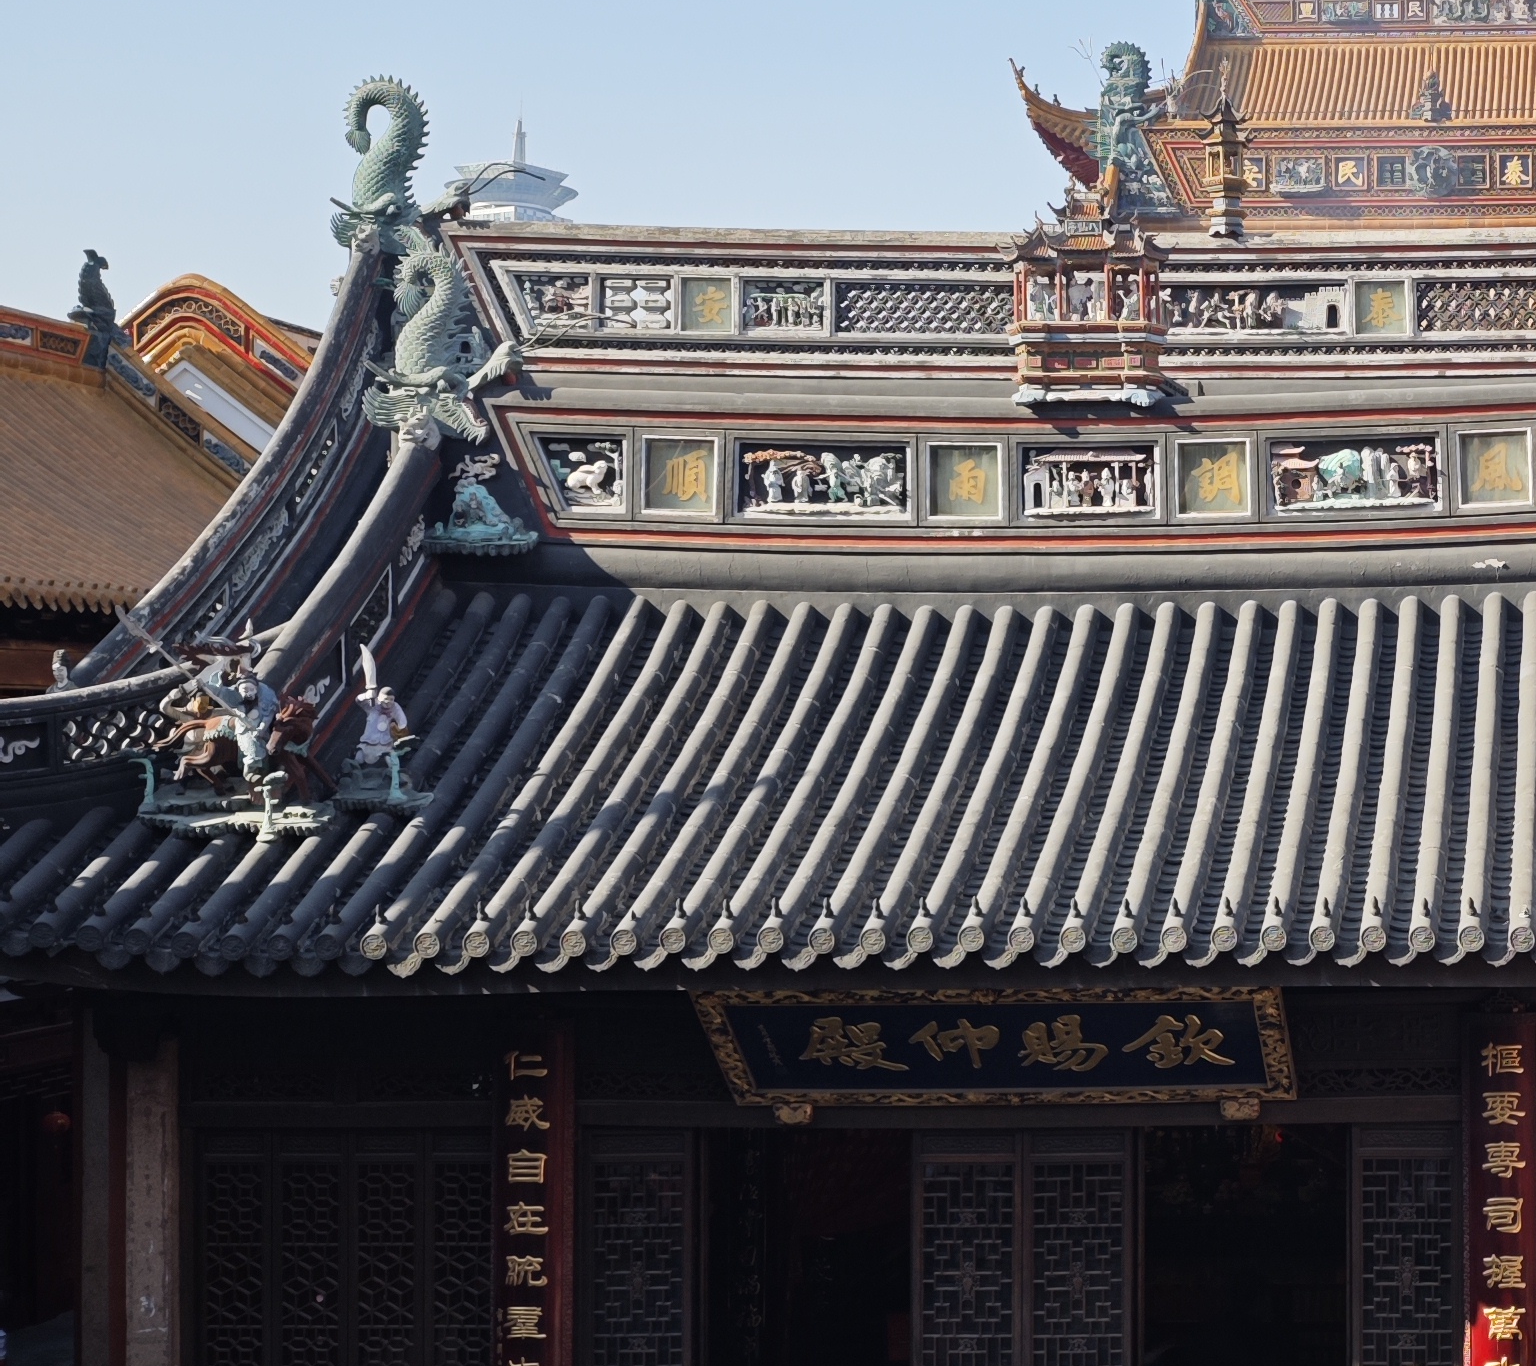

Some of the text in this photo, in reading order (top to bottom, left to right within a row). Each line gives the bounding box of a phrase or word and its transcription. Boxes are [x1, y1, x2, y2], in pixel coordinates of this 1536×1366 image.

[1337, 160, 1363, 187] 民
[1501, 155, 1529, 186] 泰
[692, 286, 1405, 329] 泰 安
[662, 449, 1524, 507] 風 調 雨 順
